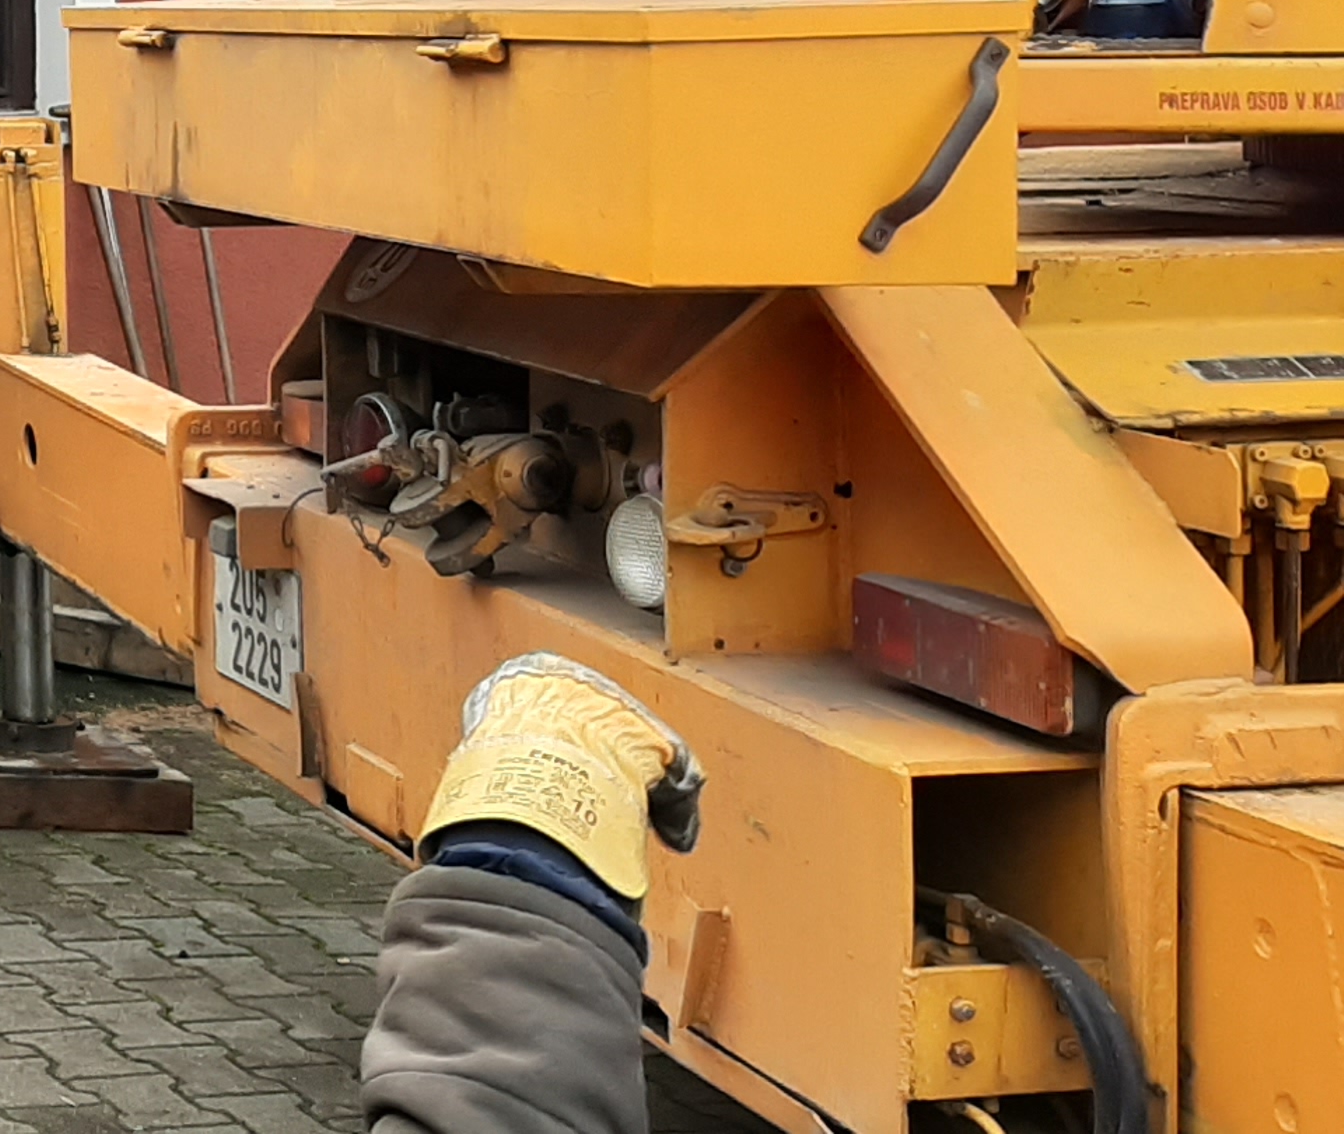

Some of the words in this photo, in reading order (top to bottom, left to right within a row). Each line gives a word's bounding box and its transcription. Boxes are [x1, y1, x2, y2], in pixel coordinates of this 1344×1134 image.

[1246, 91, 1288, 111] OSOB
[1295, 91, 1306, 111] V
[231, 619, 282, 695] 2229
